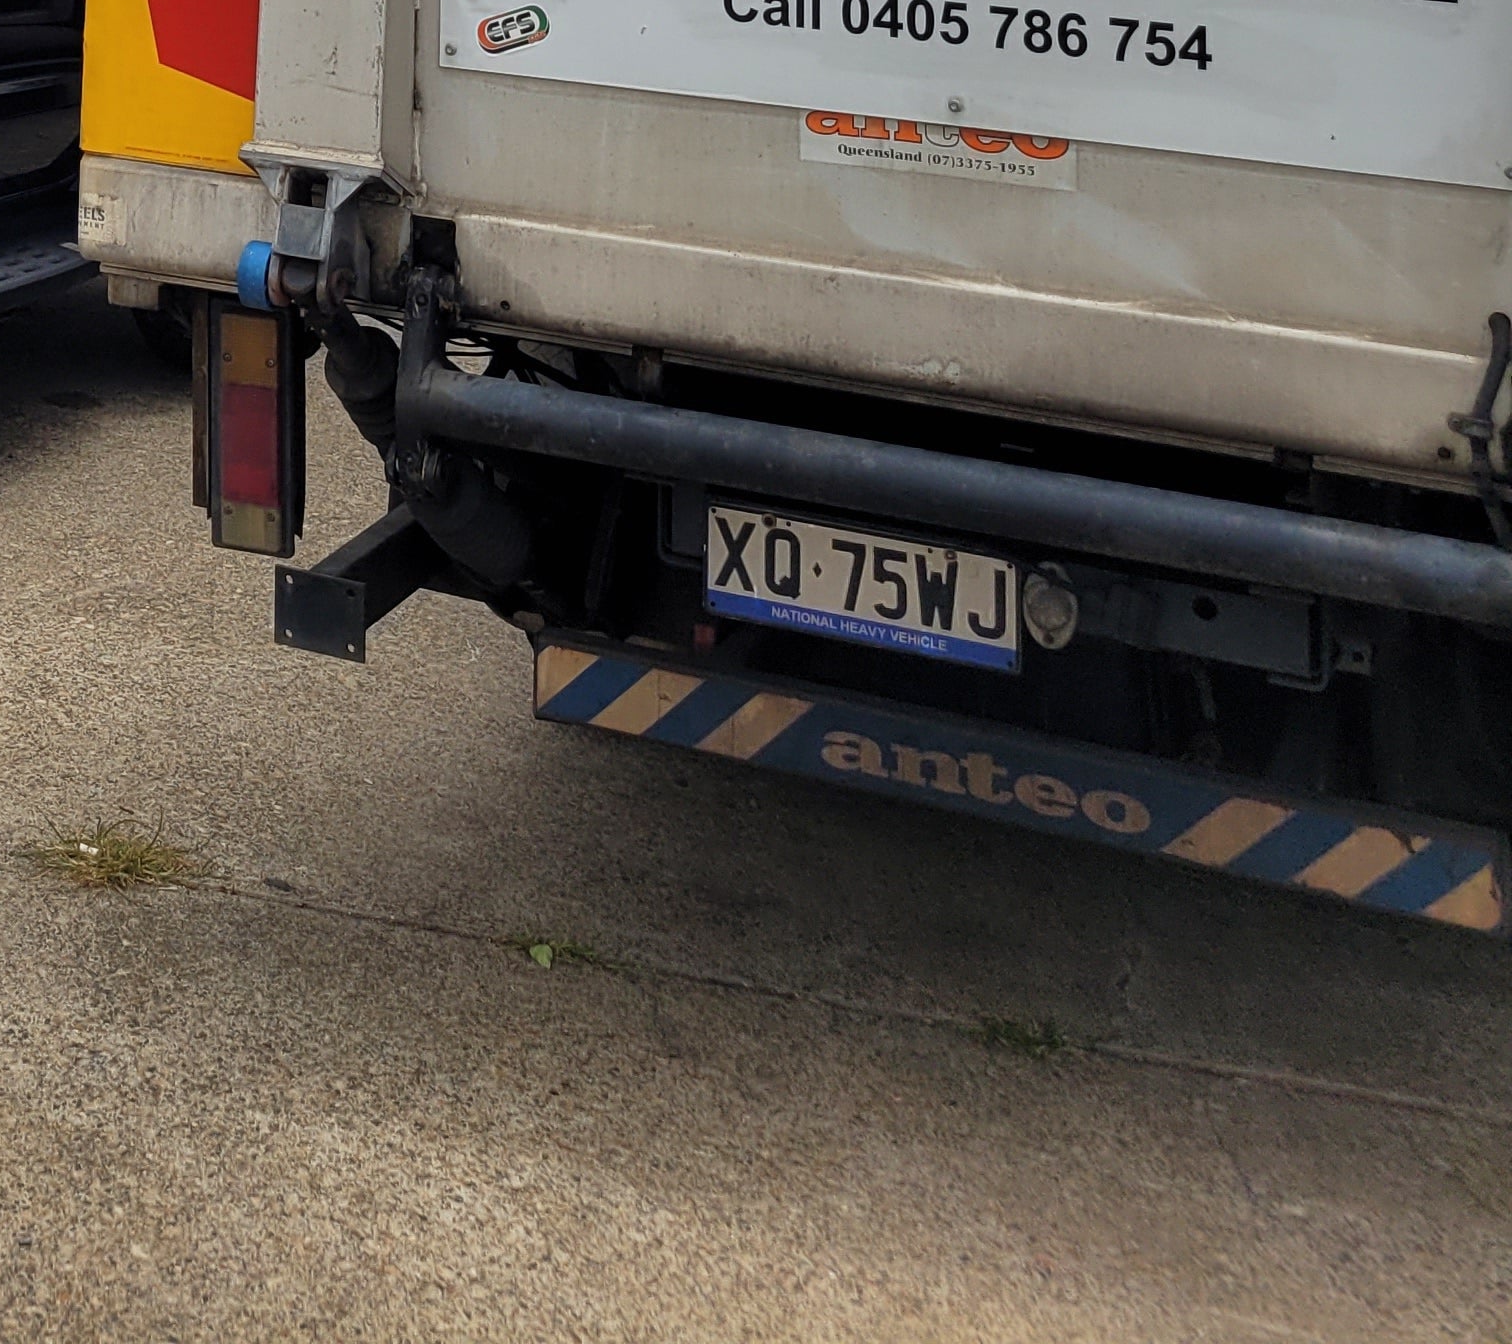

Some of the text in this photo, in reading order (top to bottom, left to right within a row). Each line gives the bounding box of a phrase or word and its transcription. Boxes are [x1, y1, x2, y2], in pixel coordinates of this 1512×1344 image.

[486, 11, 536, 43] EFS
[988, 5, 1089, 58] 786
[1108, 16, 1214, 72] 754
[837, 143, 1036, 177] Queensland (07)3375-1955
[714, 515, 1007, 640] XQ 75WJ
[771, 604, 948, 652] NATIONAL HEAVY VEHICLE
[820, 728, 1152, 836] anteo
